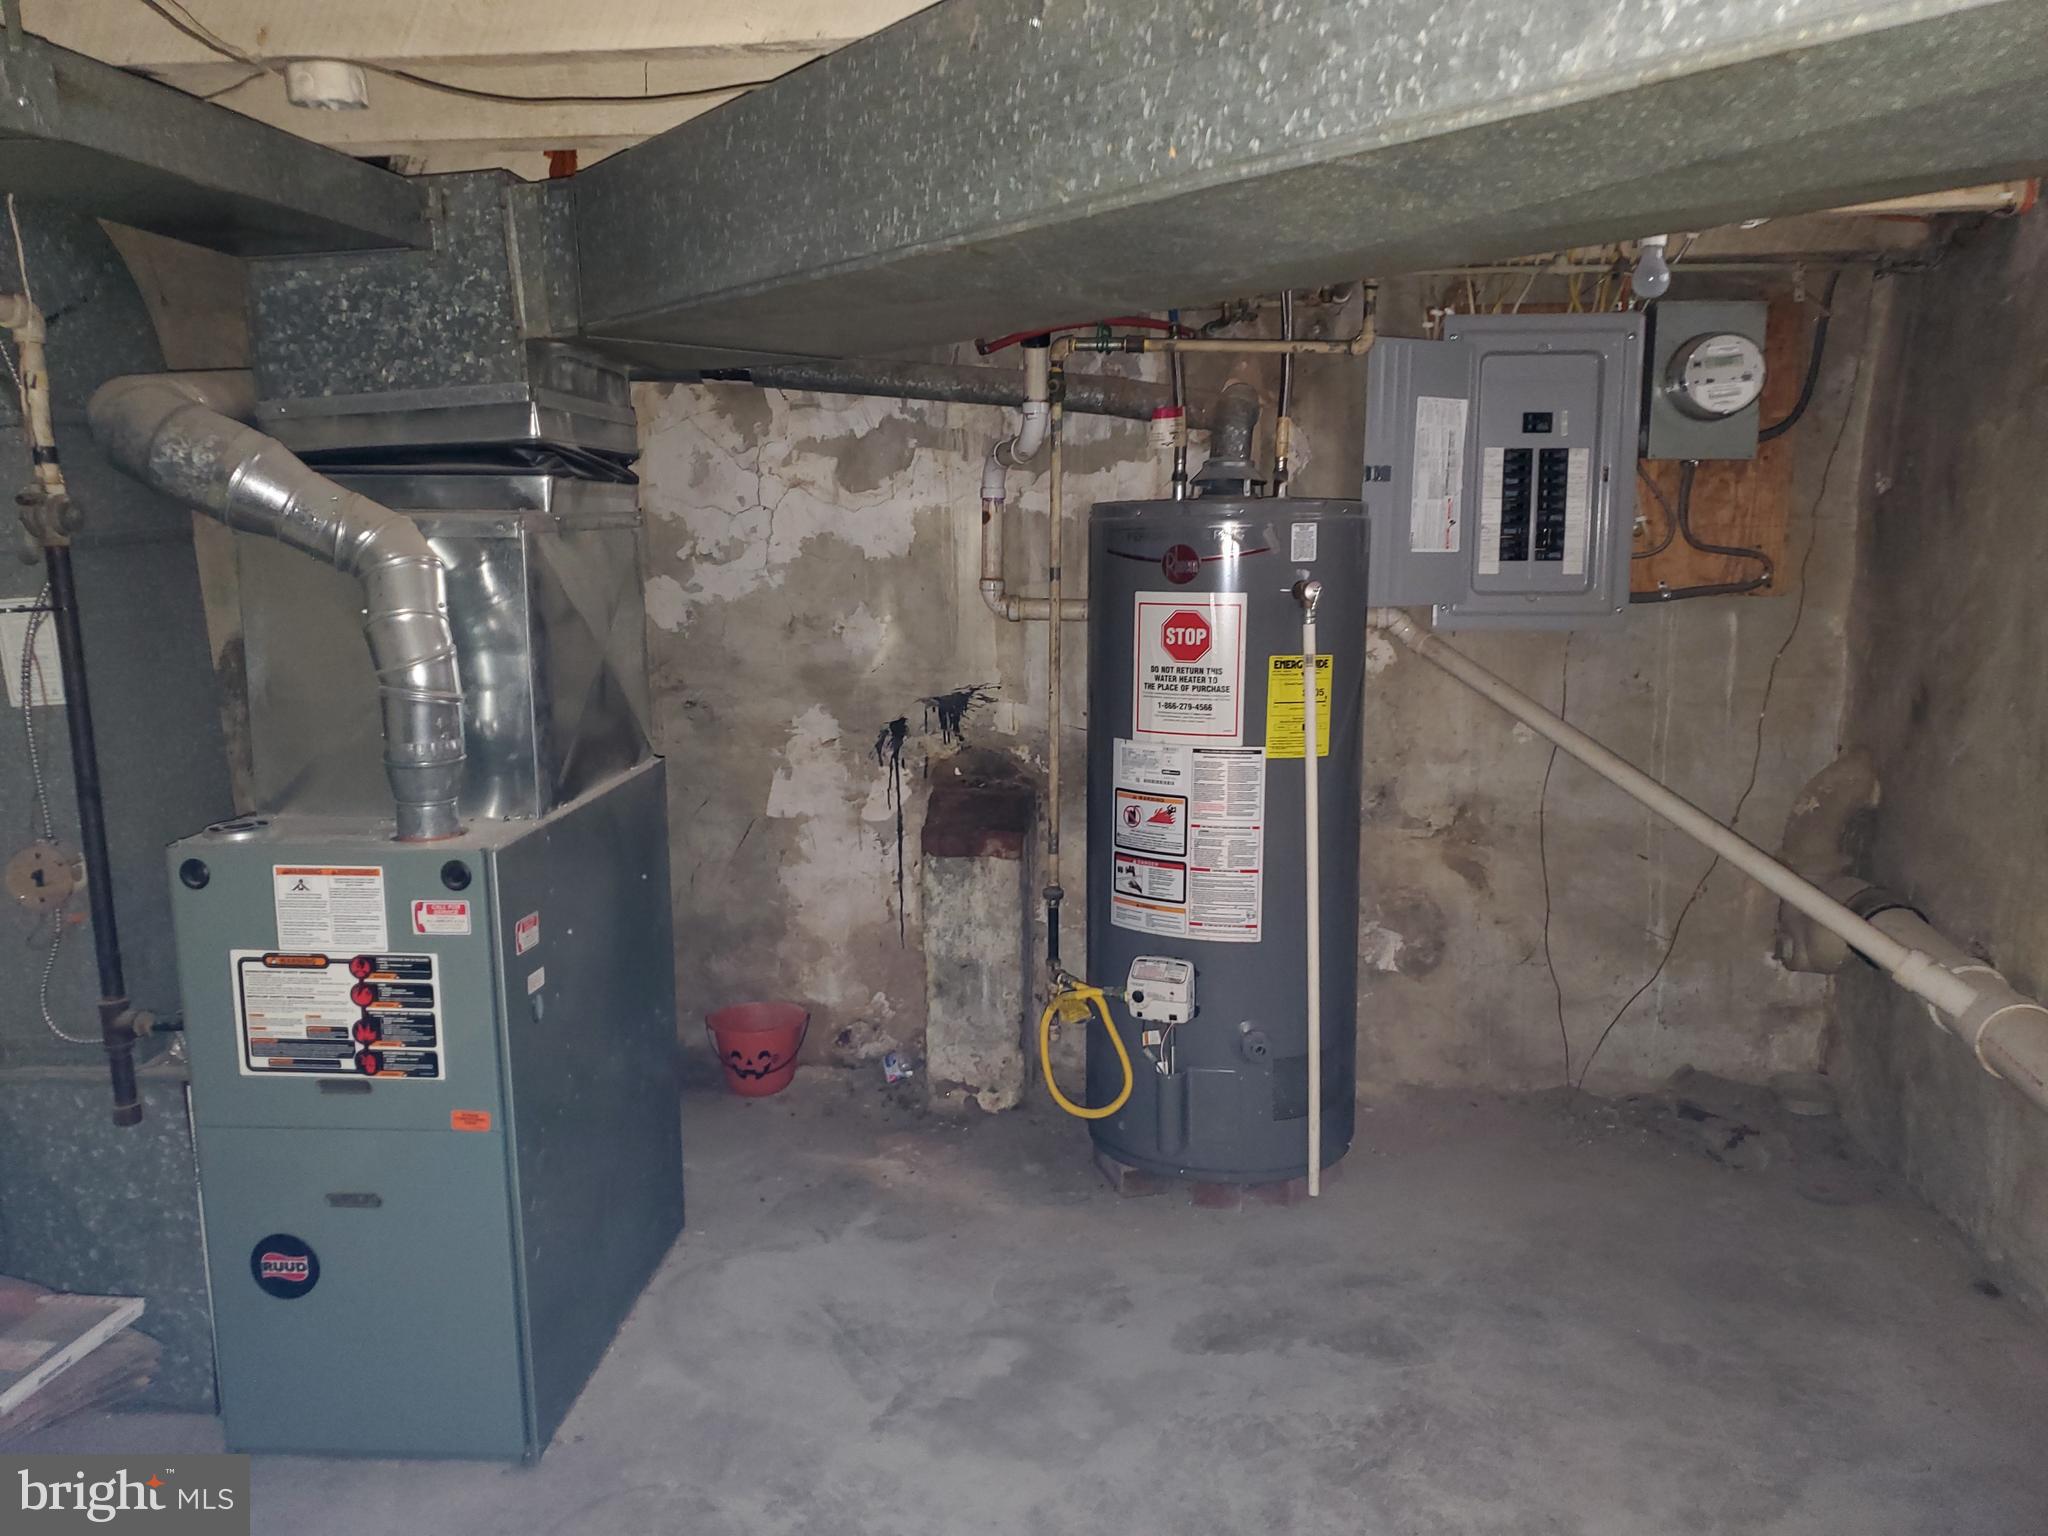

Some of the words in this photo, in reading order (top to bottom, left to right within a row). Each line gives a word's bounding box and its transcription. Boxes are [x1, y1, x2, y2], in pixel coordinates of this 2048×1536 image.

[1166, 627, 1207, 646] STOP
[1150, 665, 1159, 673] DO
[1161, 666, 1174, 674] NOT
[1176, 667, 1204, 675] RETURN
[1206, 667, 1223, 675] THIS
[1154, 674, 1177, 683] WATER
[1179, 675, 1206, 684] HEATER
[1208, 676, 1218, 684] TO
[1144, 682, 1155, 690] THE
[1157, 683, 1178, 692] PLACE
[1181, 684, 1190, 692] OF
[1192, 685, 1231, 693] PURCHASE
[263, 1262, 307, 1272] RUUD
